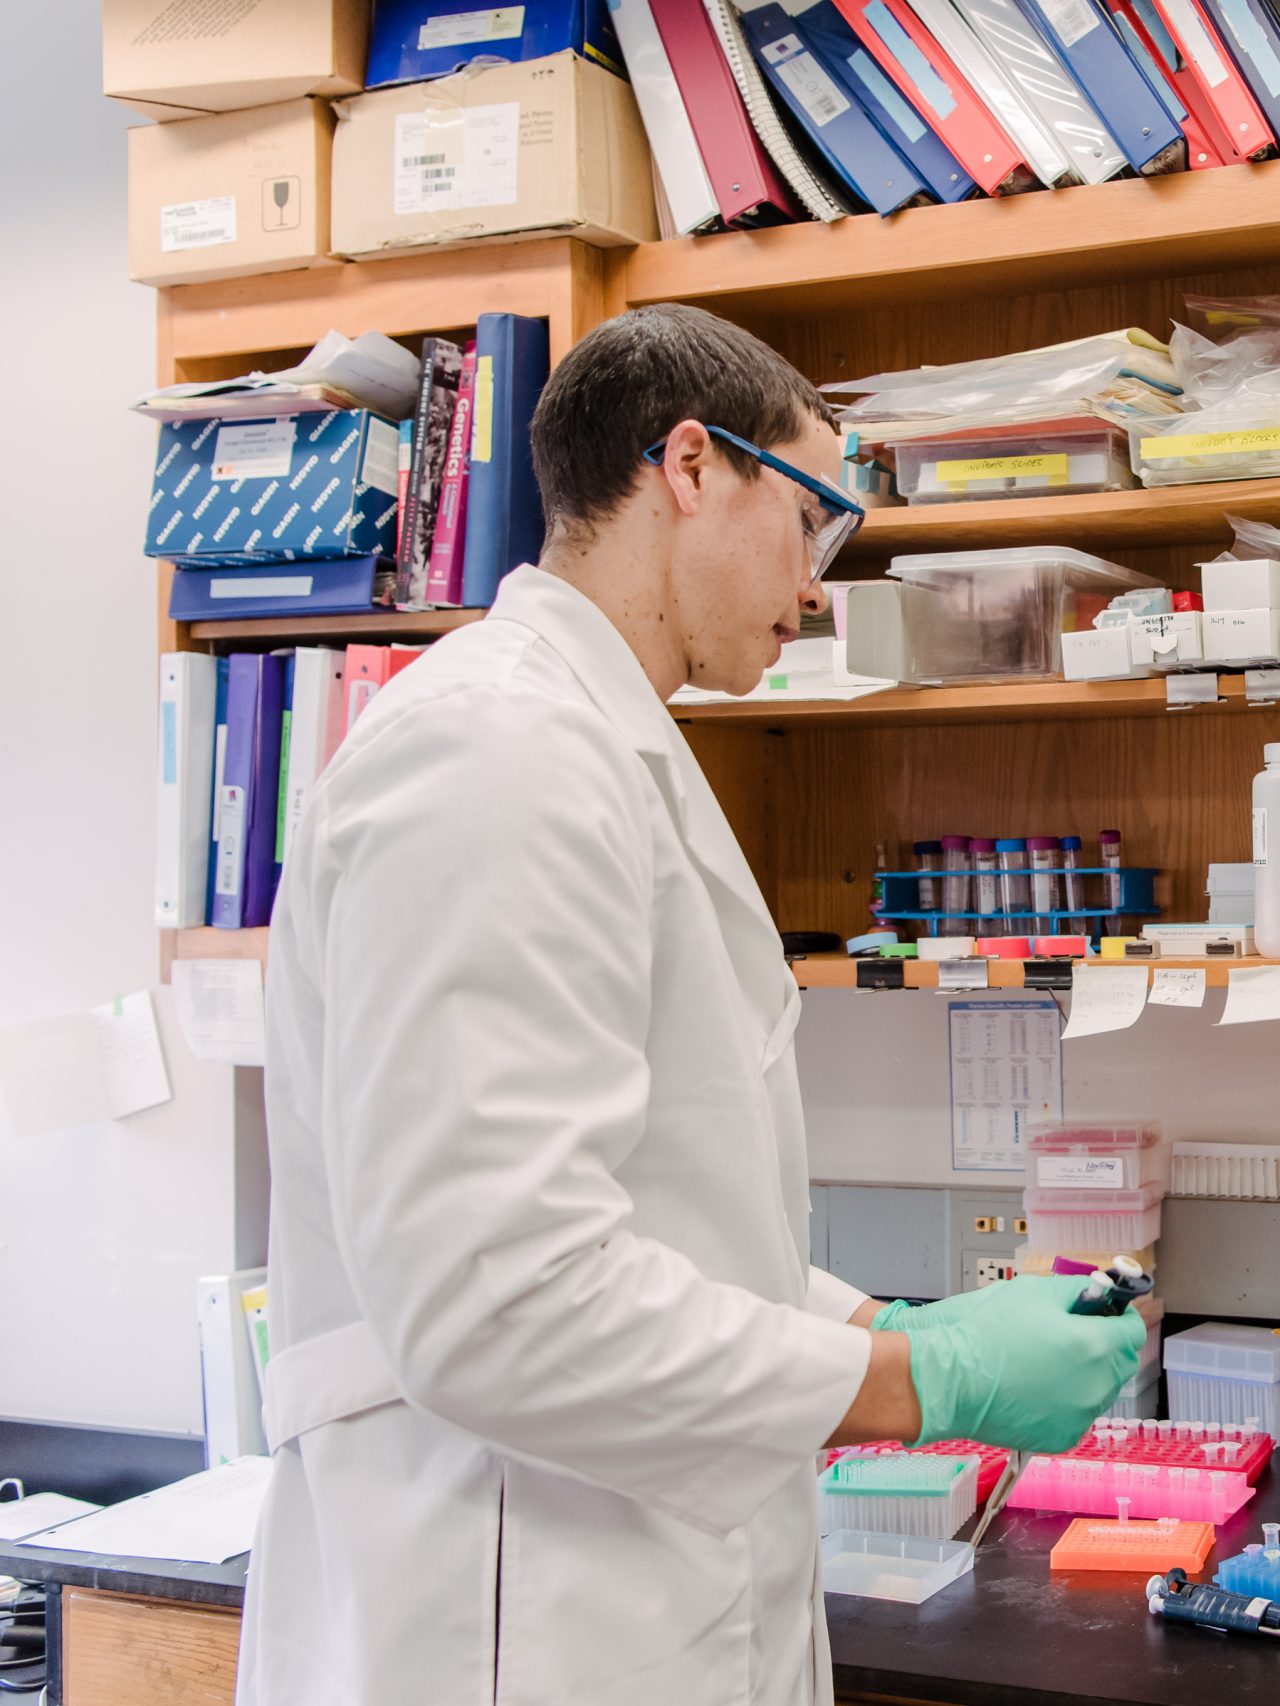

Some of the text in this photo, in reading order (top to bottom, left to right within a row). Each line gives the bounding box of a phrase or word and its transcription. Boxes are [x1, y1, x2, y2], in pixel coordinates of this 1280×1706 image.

[330, 428, 360, 464] QIAGEN
[445, 398, 470, 478] Genetics
[250, 480, 280, 517] QIAGEN
[156, 508, 184, 546] QIAGEN
[272, 502, 302, 540] QIAGEN
